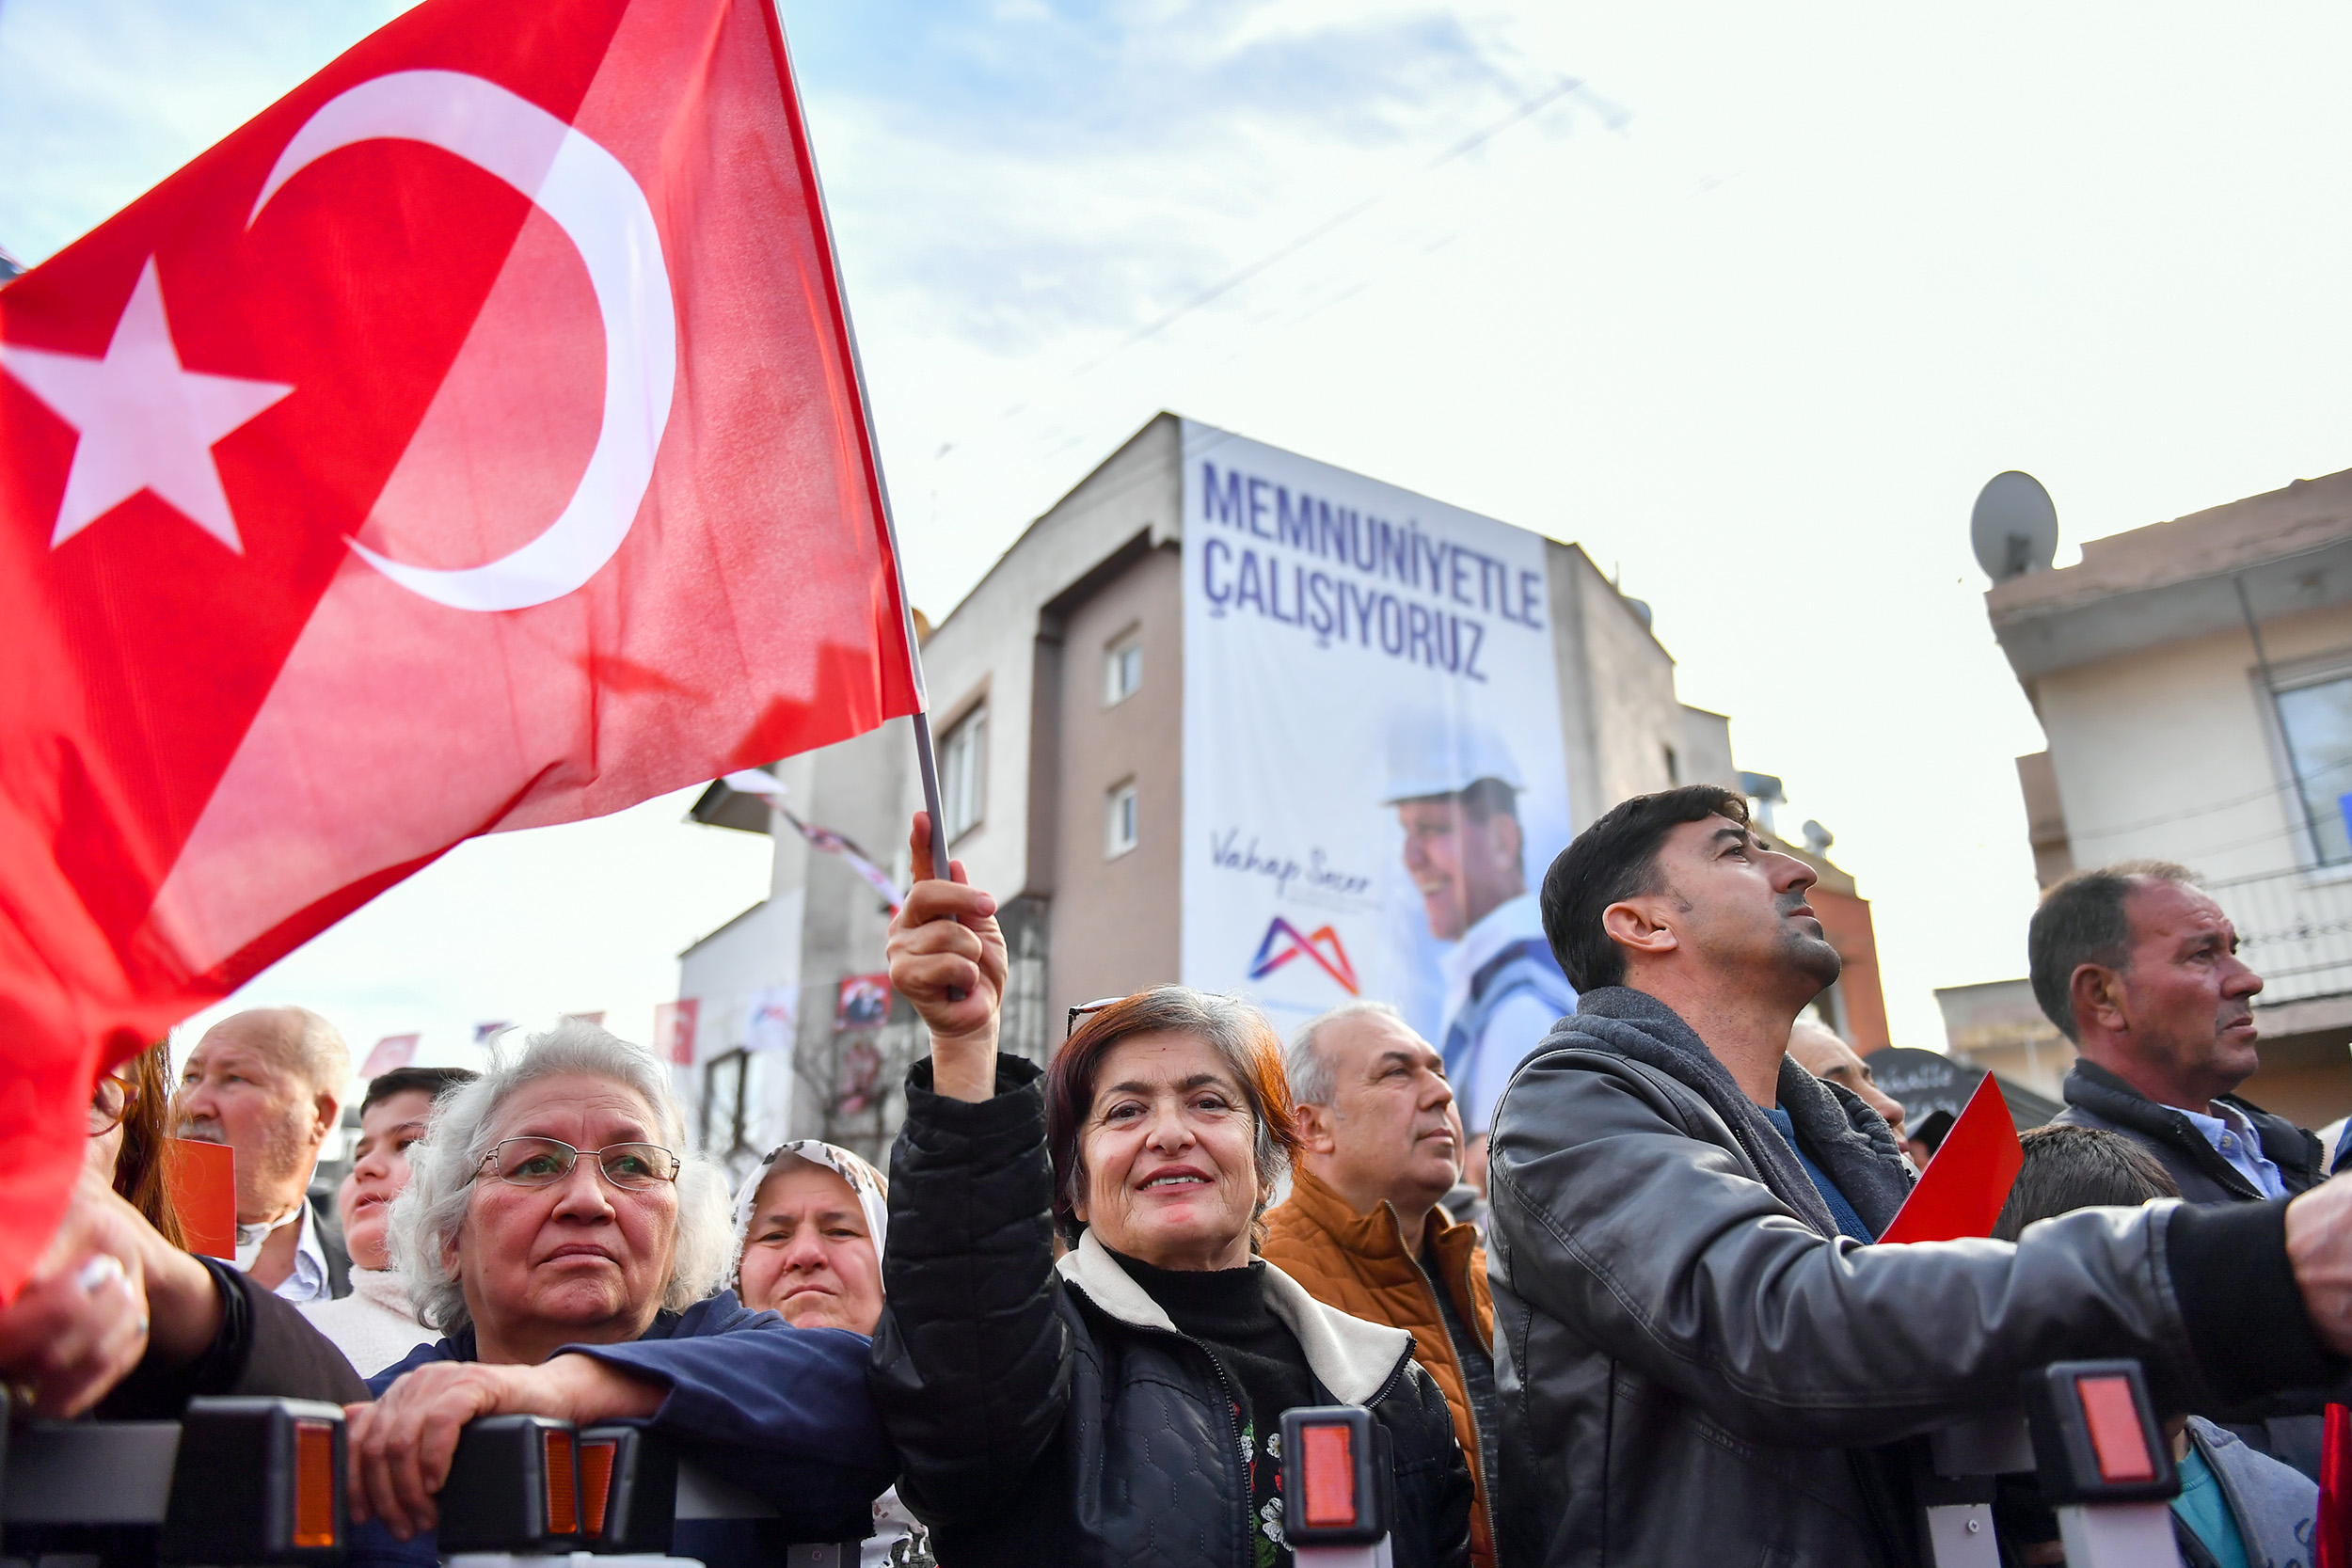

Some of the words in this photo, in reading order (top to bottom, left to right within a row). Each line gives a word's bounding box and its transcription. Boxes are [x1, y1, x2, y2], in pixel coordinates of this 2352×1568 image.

[1202, 461, 1544, 630] MEMNUNİYETLE
[1202, 538, 1487, 683] ÇALIŞIYORUZ
[1212, 826, 1300, 897] Vahap
